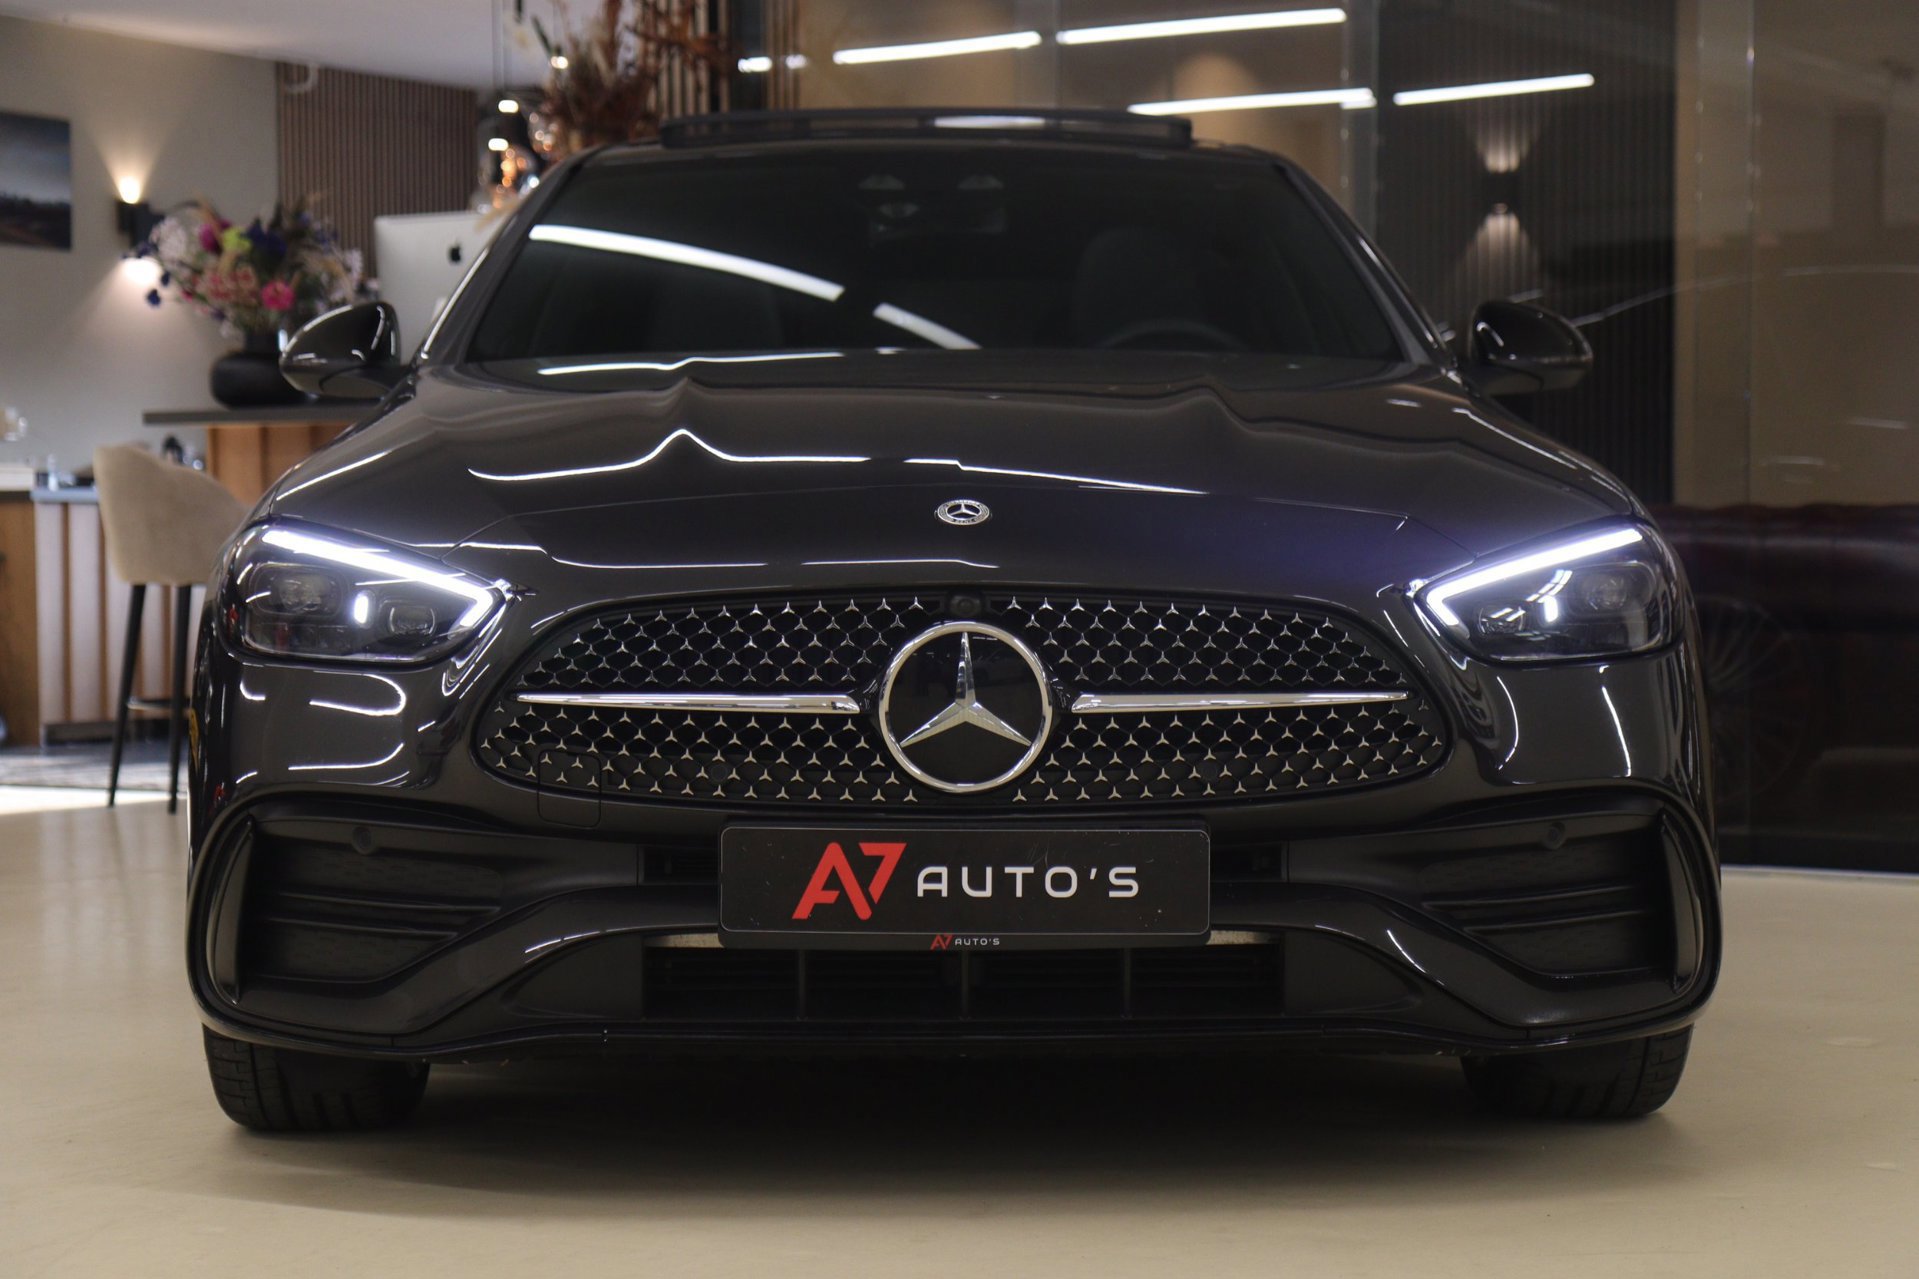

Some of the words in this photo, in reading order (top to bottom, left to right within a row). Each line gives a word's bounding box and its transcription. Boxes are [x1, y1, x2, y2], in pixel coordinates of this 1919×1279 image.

[791, 842, 907, 921] A7
[917, 866, 1139, 898] AUTO'S
[930, 934, 953, 950] A7
[954, 938, 1000, 946] AUTO'S
